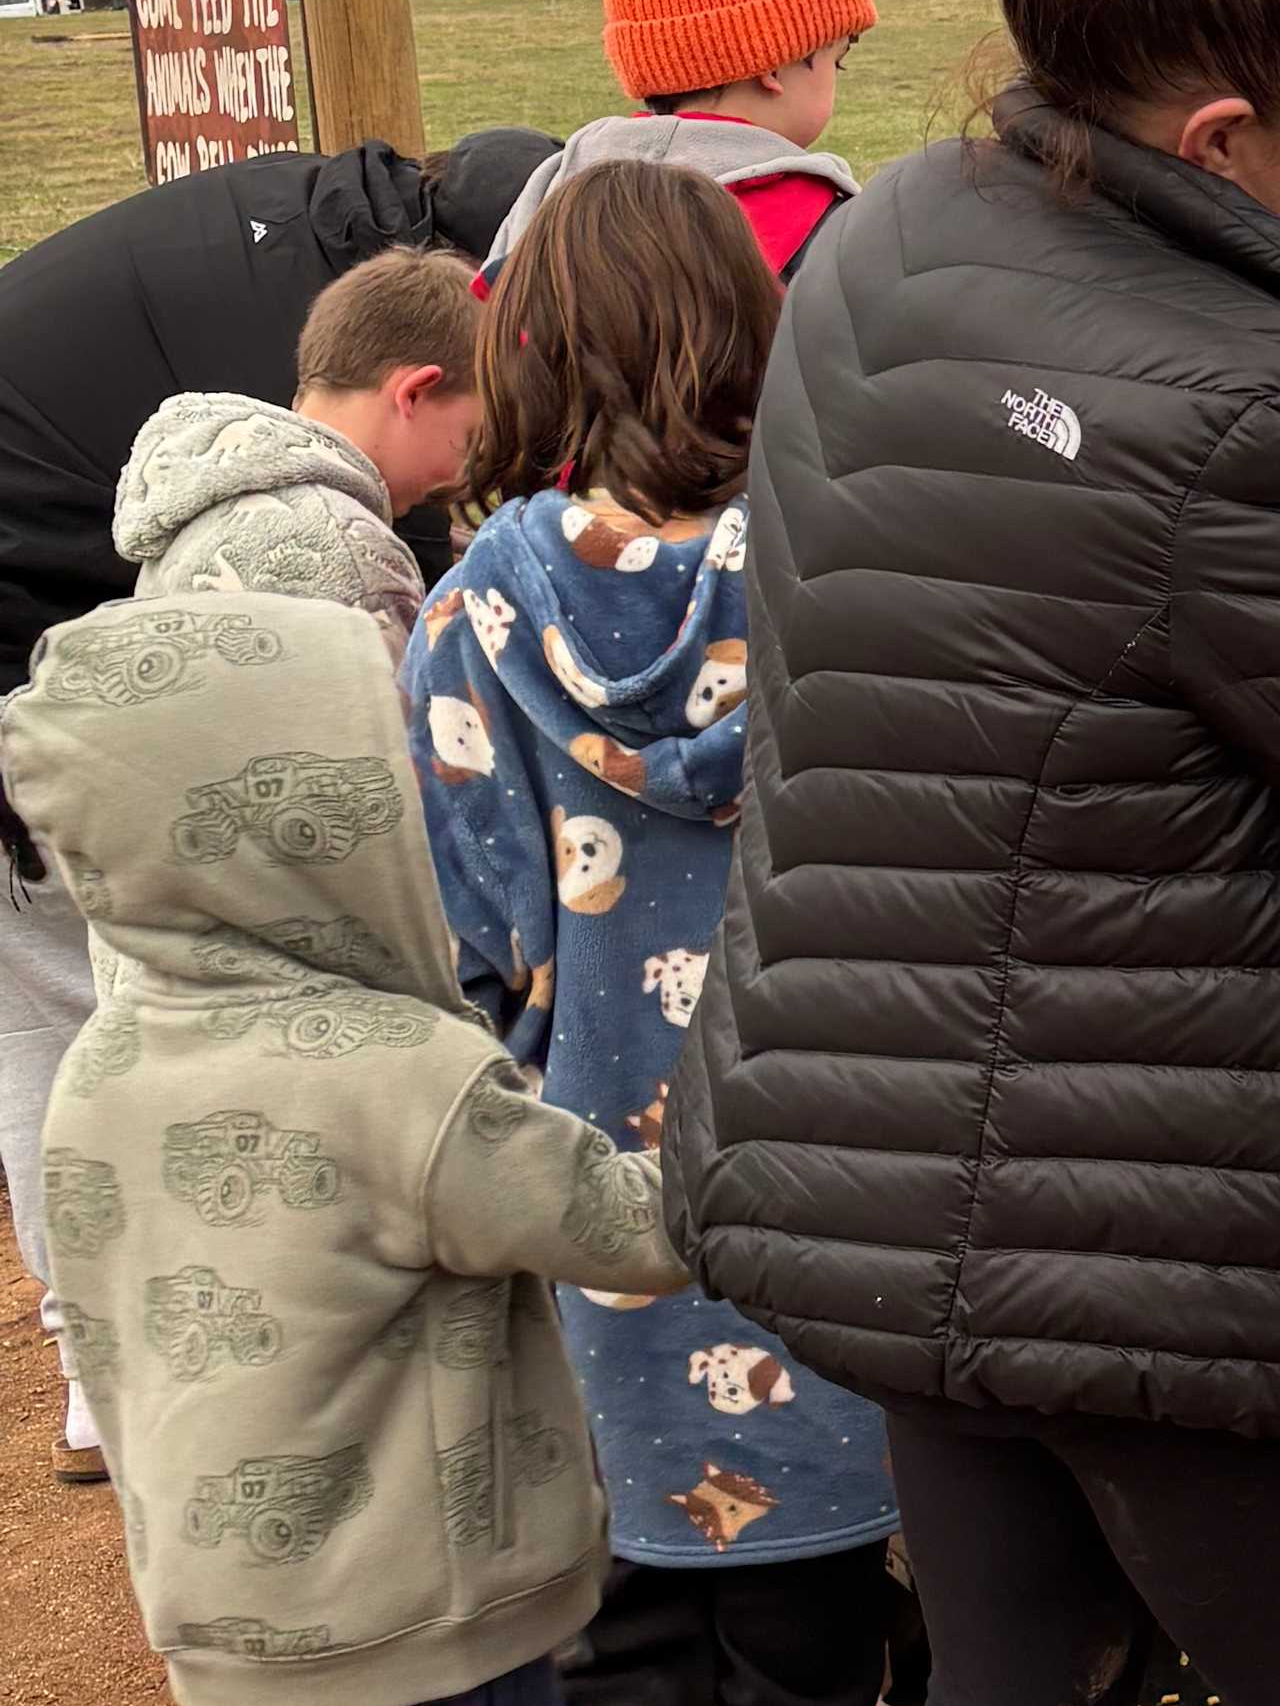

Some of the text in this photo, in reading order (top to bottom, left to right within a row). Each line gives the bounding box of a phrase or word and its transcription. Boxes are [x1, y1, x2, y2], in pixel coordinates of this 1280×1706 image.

[146, 45, 294, 124] ANIMALS WHEN THE
[1001, 389, 1058, 432] NORTH
[1033, 388, 1064, 417] THE
[1007, 412, 1053, 446] FACE
[254, 777, 284, 797] 07
[234, 1133, 261, 1153] 07
